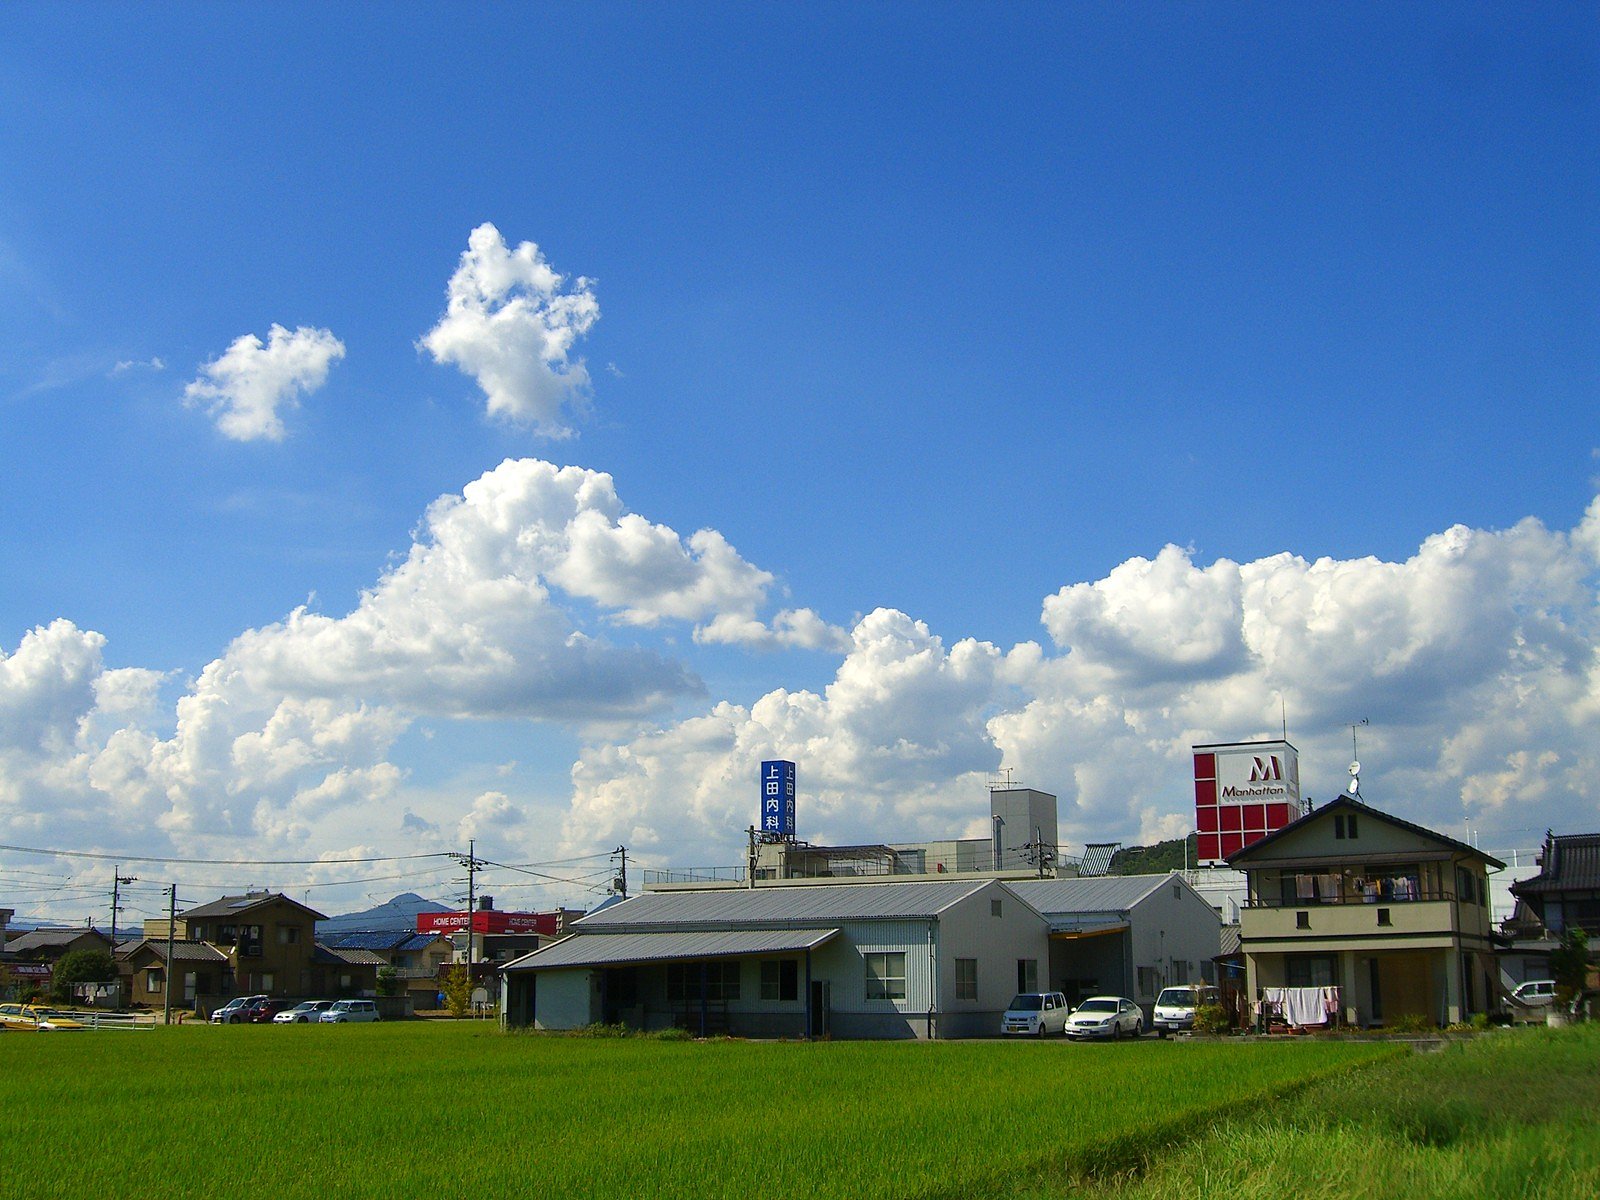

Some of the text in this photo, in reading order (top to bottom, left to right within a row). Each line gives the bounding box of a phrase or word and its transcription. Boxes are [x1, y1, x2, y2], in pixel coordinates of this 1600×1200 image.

[1249, 756, 1281, 781] M
[766, 765, 779, 829] 上田内科
[786, 766, 794, 829] 上田内科
[1222, 786, 1283, 798] Manhattan
[433, 917, 471, 926] HOME CENTE
[508, 918, 537, 927] HOME CENTER
